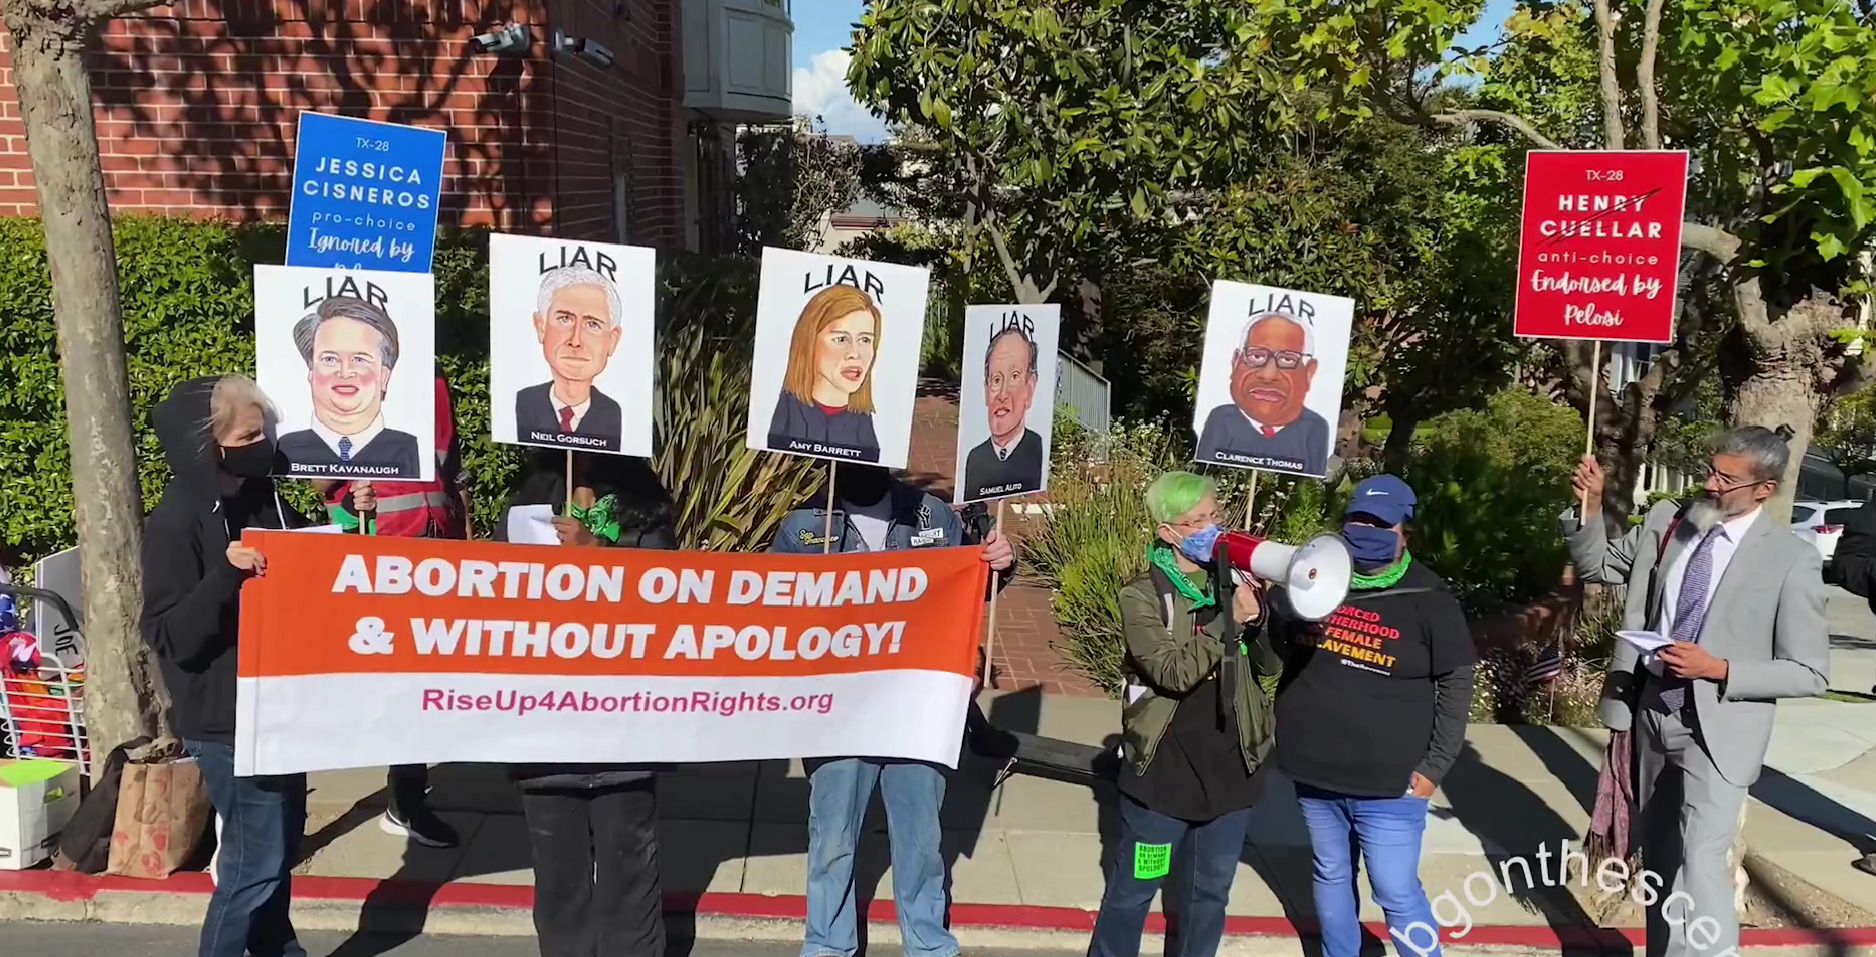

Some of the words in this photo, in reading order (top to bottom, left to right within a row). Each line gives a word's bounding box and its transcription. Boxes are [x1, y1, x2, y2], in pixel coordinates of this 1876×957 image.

[356, 137, 389, 151] TX-28
[315, 157, 422, 184] JESSICA
[1585, 170, 1623, 181] TX-28
[303, 180, 430, 209] CISNEROS
[1558, 194, 1646, 212] HENRY
[312, 211, 416, 231] pro-choice
[1540, 220, 1662, 238] CUELLAR
[308, 227, 385, 258] Ignored
[390, 237, 415, 263] by
[539, 246, 617, 283] LIAR
[1538, 250, 1658, 265] anti-choice
[303, 275, 389, 314] LIAR
[804, 264, 884, 305] LIAR
[1531, 269, 1627, 296] Endorsed
[1632, 273, 1662, 300] by
[1249, 293, 1315, 326] LIAR
[1564, 303, 1623, 327] Pelosi
[989, 310, 1034, 343] LIAR
[531, 431, 555, 442] NEIL
[557, 434, 607, 447] GORSUCH
[789, 441, 812, 451] AMY
[814, 444, 861, 457] BARRETT
[291, 463, 327, 473] BRETT
[329, 464, 399, 475] KAVANAUGH
[1215, 451, 1264, 466] CLARENCE
[1266, 458, 1303, 470] THOMAS
[331, 554, 625, 602] ABORTION
[638, 567, 715, 603] ON
[727, 567, 928, 607] DEMAND
[1337, 605, 1380, 622] ORCED
[348, 616, 395, 655] &
[409, 618, 656, 659] WITHOUT
[663, 621, 906, 661] APOLOGY!
[1325, 626, 1382, 649] FEMALE
[422, 689, 833, 717] RiseUp4AbortionRights.org
